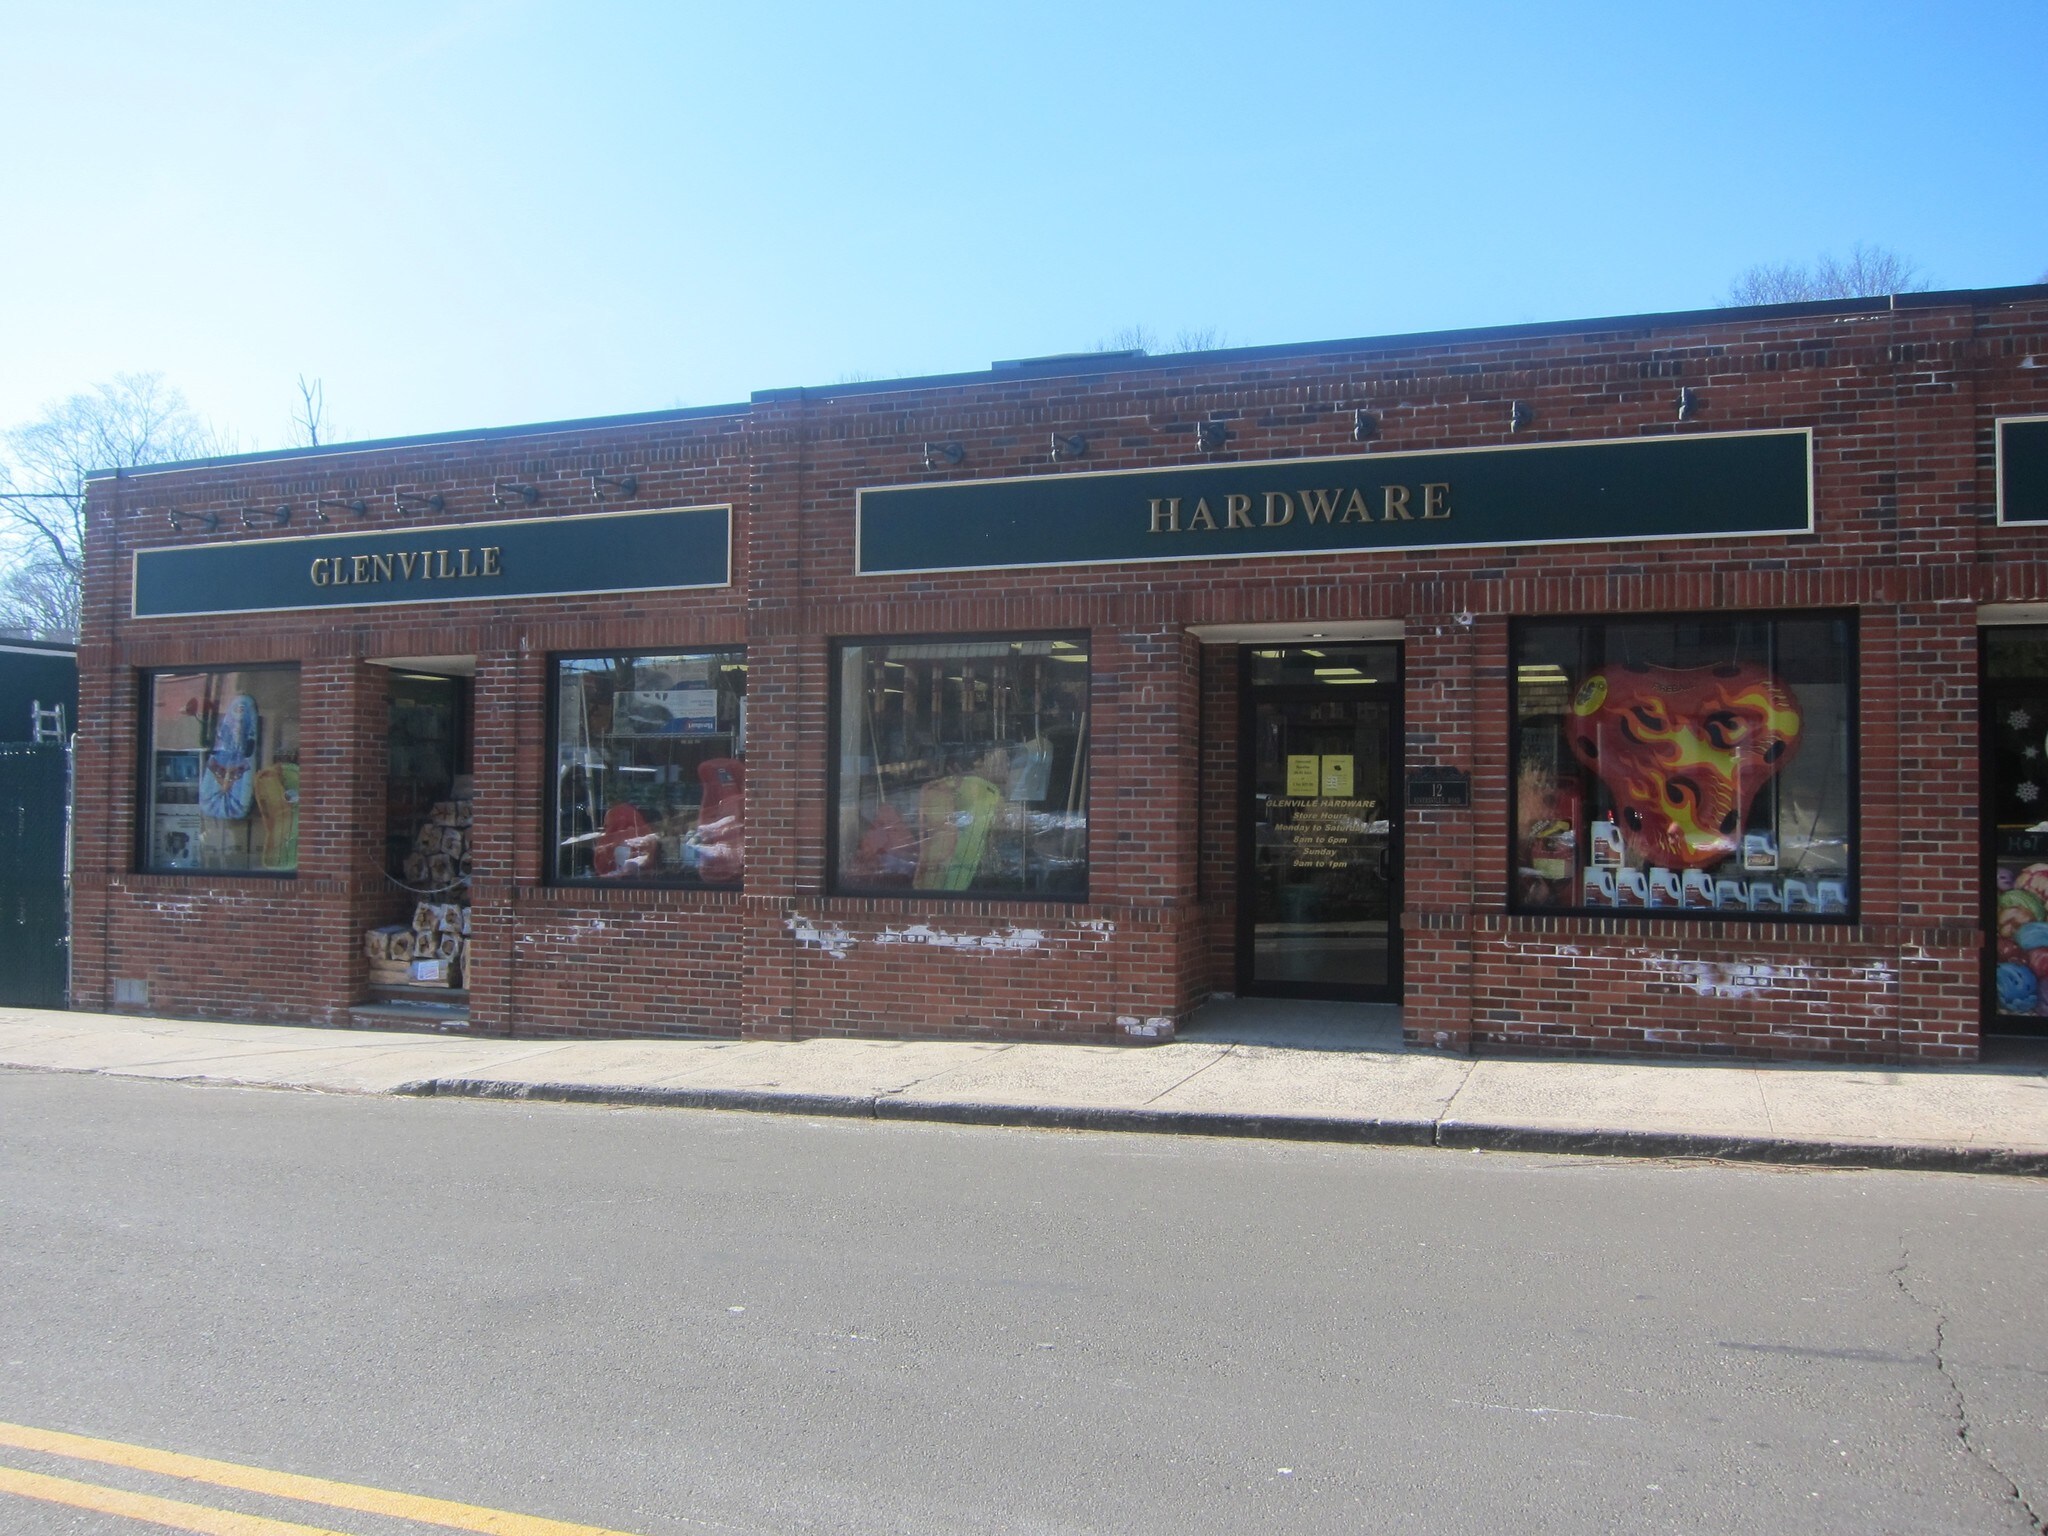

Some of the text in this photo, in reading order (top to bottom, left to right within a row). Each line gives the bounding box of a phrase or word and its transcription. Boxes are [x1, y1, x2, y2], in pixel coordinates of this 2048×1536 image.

[1146, 482, 1452, 533] HARDWARE
[311, 546, 501, 587] GLENVILLE
[1432, 783, 1443, 797] 12
[1265, 800, 1376, 808] GLENVILLE HARDWARE
[1320, 812, 1349, 820] Hours
[1274, 824, 1310, 832] Monday
[1324, 824, 1367, 833] Saturday
[1293, 836, 1313, 844] 8am
[1327, 836, 1348, 845] 6pm
[1302, 848, 1337, 857] Sunday
[1293, 860, 1313, 868] 9am
[1328, 860, 1348, 869] 1pm
